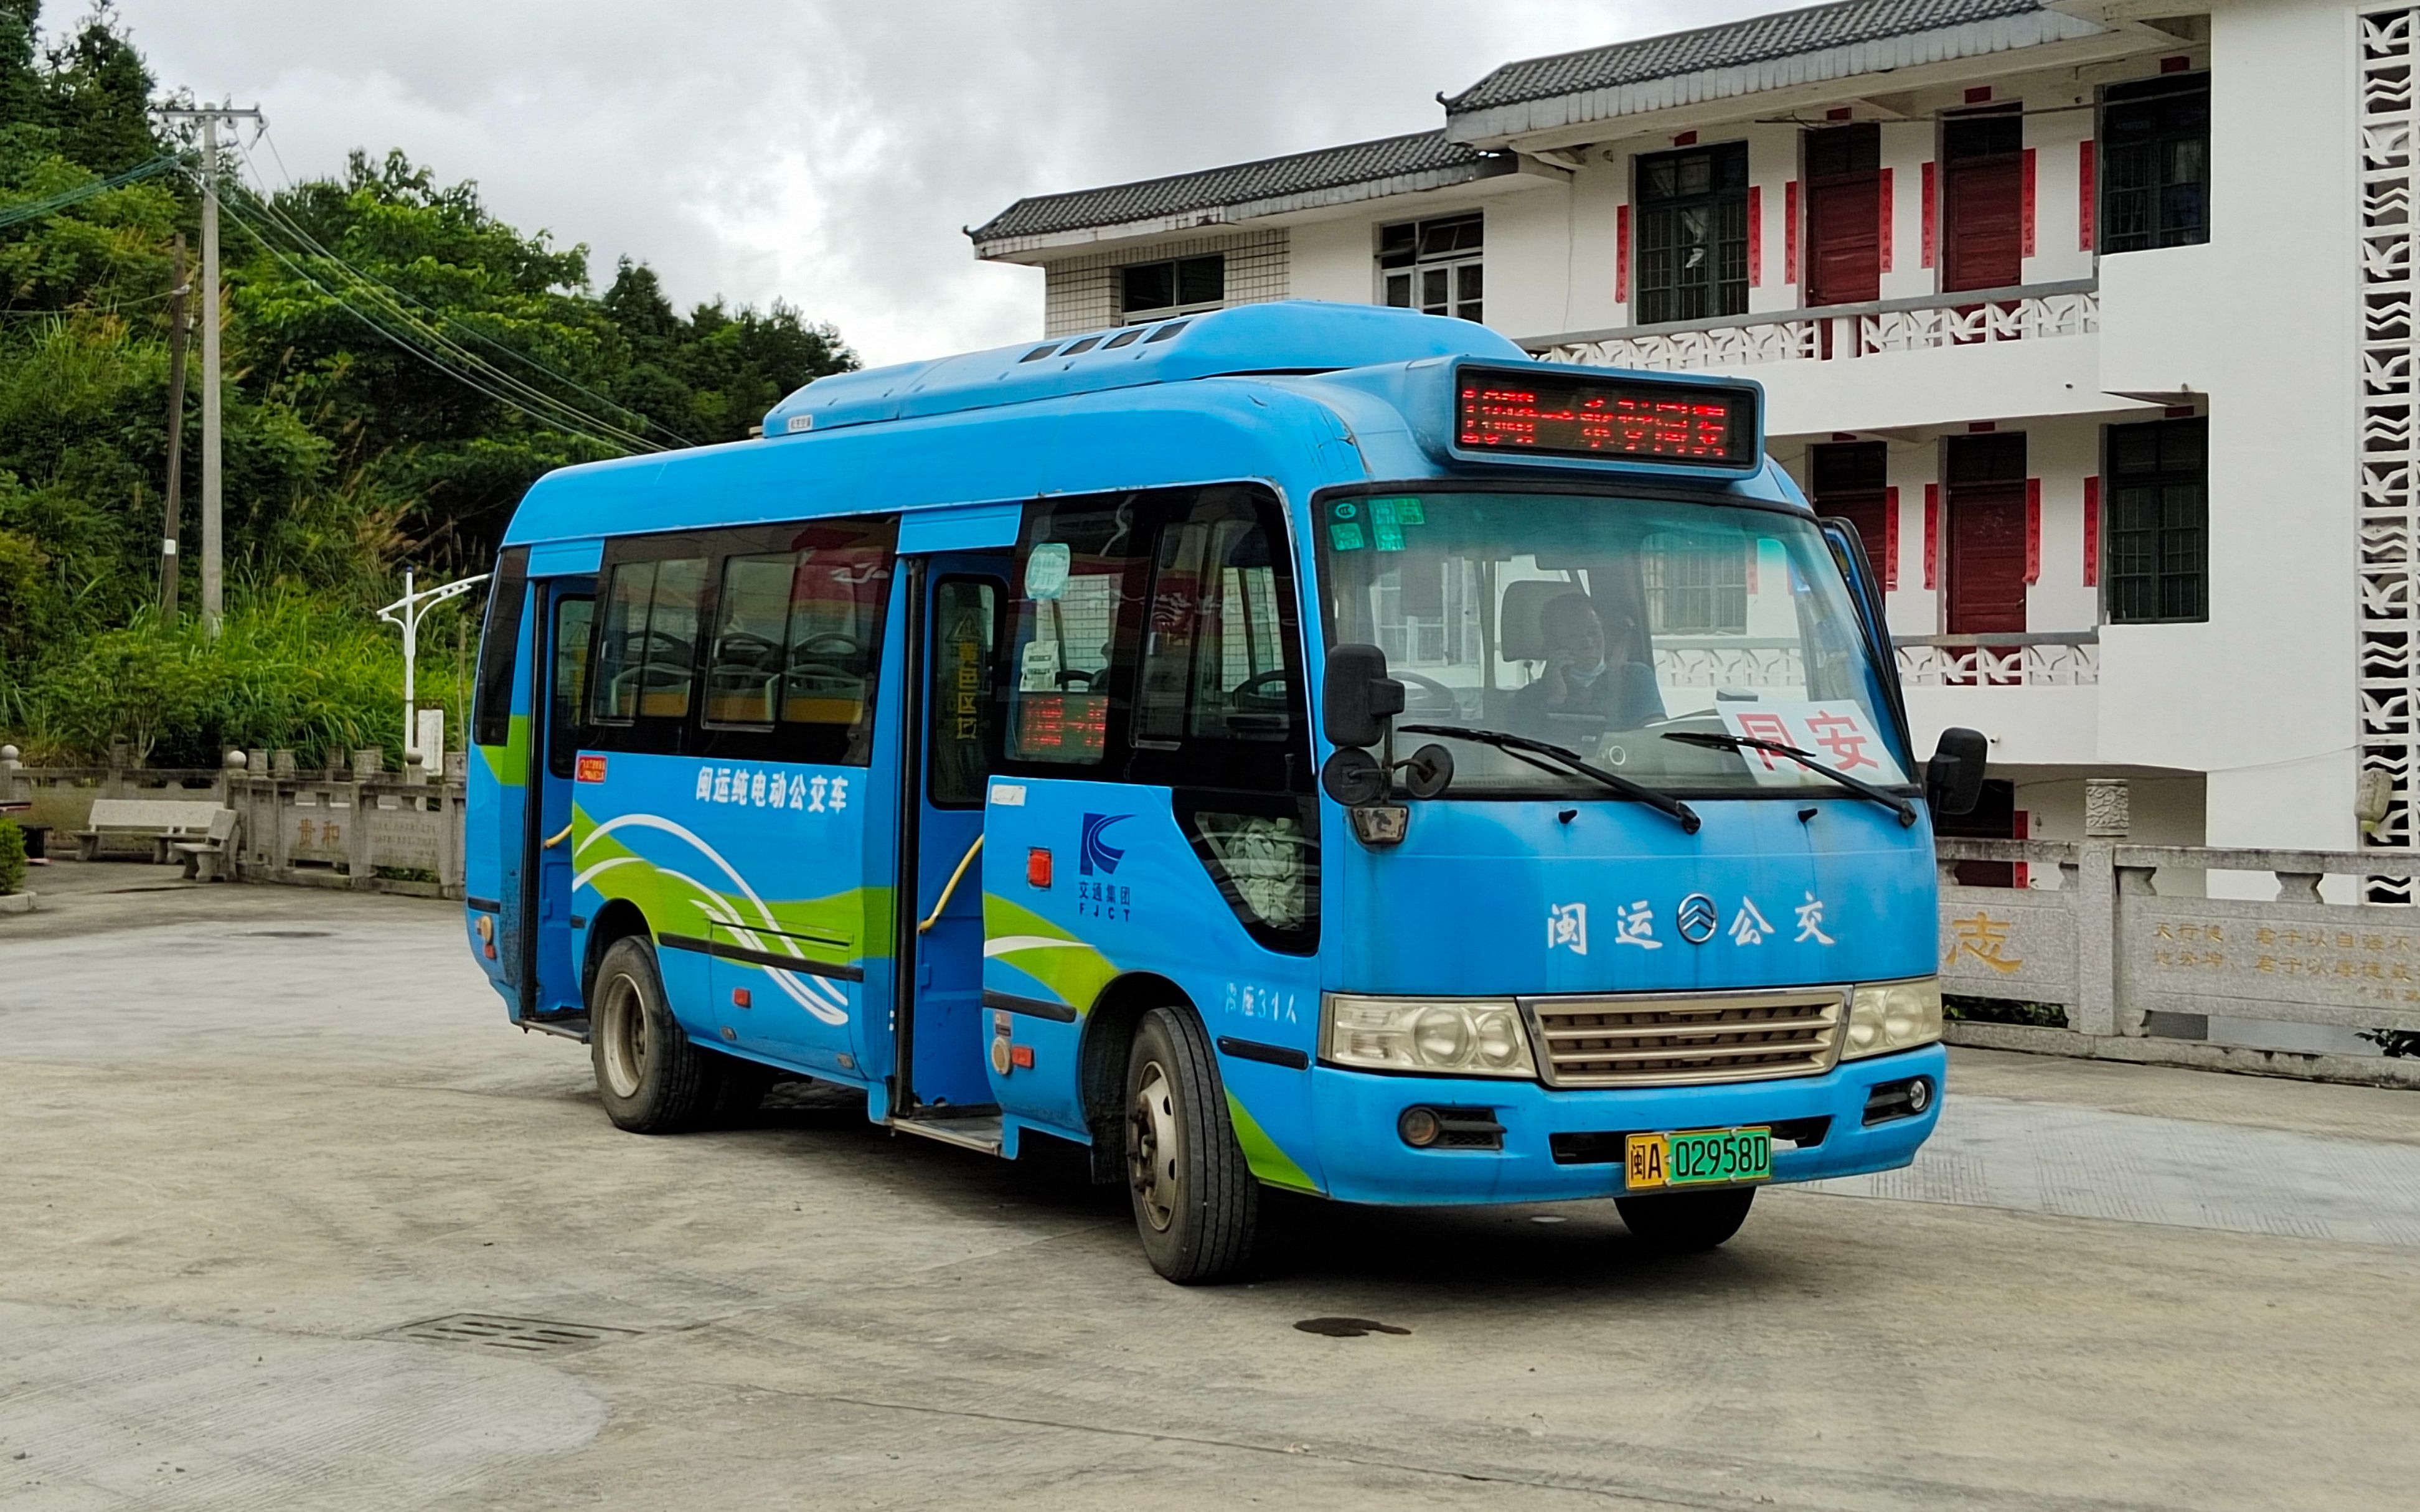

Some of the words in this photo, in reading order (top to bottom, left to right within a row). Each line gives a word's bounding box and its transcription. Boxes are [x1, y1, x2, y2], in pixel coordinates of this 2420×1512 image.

[1736, 710, 1878, 771] 同安
[696, 766, 848, 814] 闽运纯电动公交车
[1079, 880, 1130, 906] 交通集团
[1547, 899, 1663, 955] 闽运
[1728, 891, 1836, 946] 公交
[1945, 910, 2023, 974] 志
[1631, 1143, 1662, 1180] 闽A
[1675, 1136, 1768, 1176] 02958D
